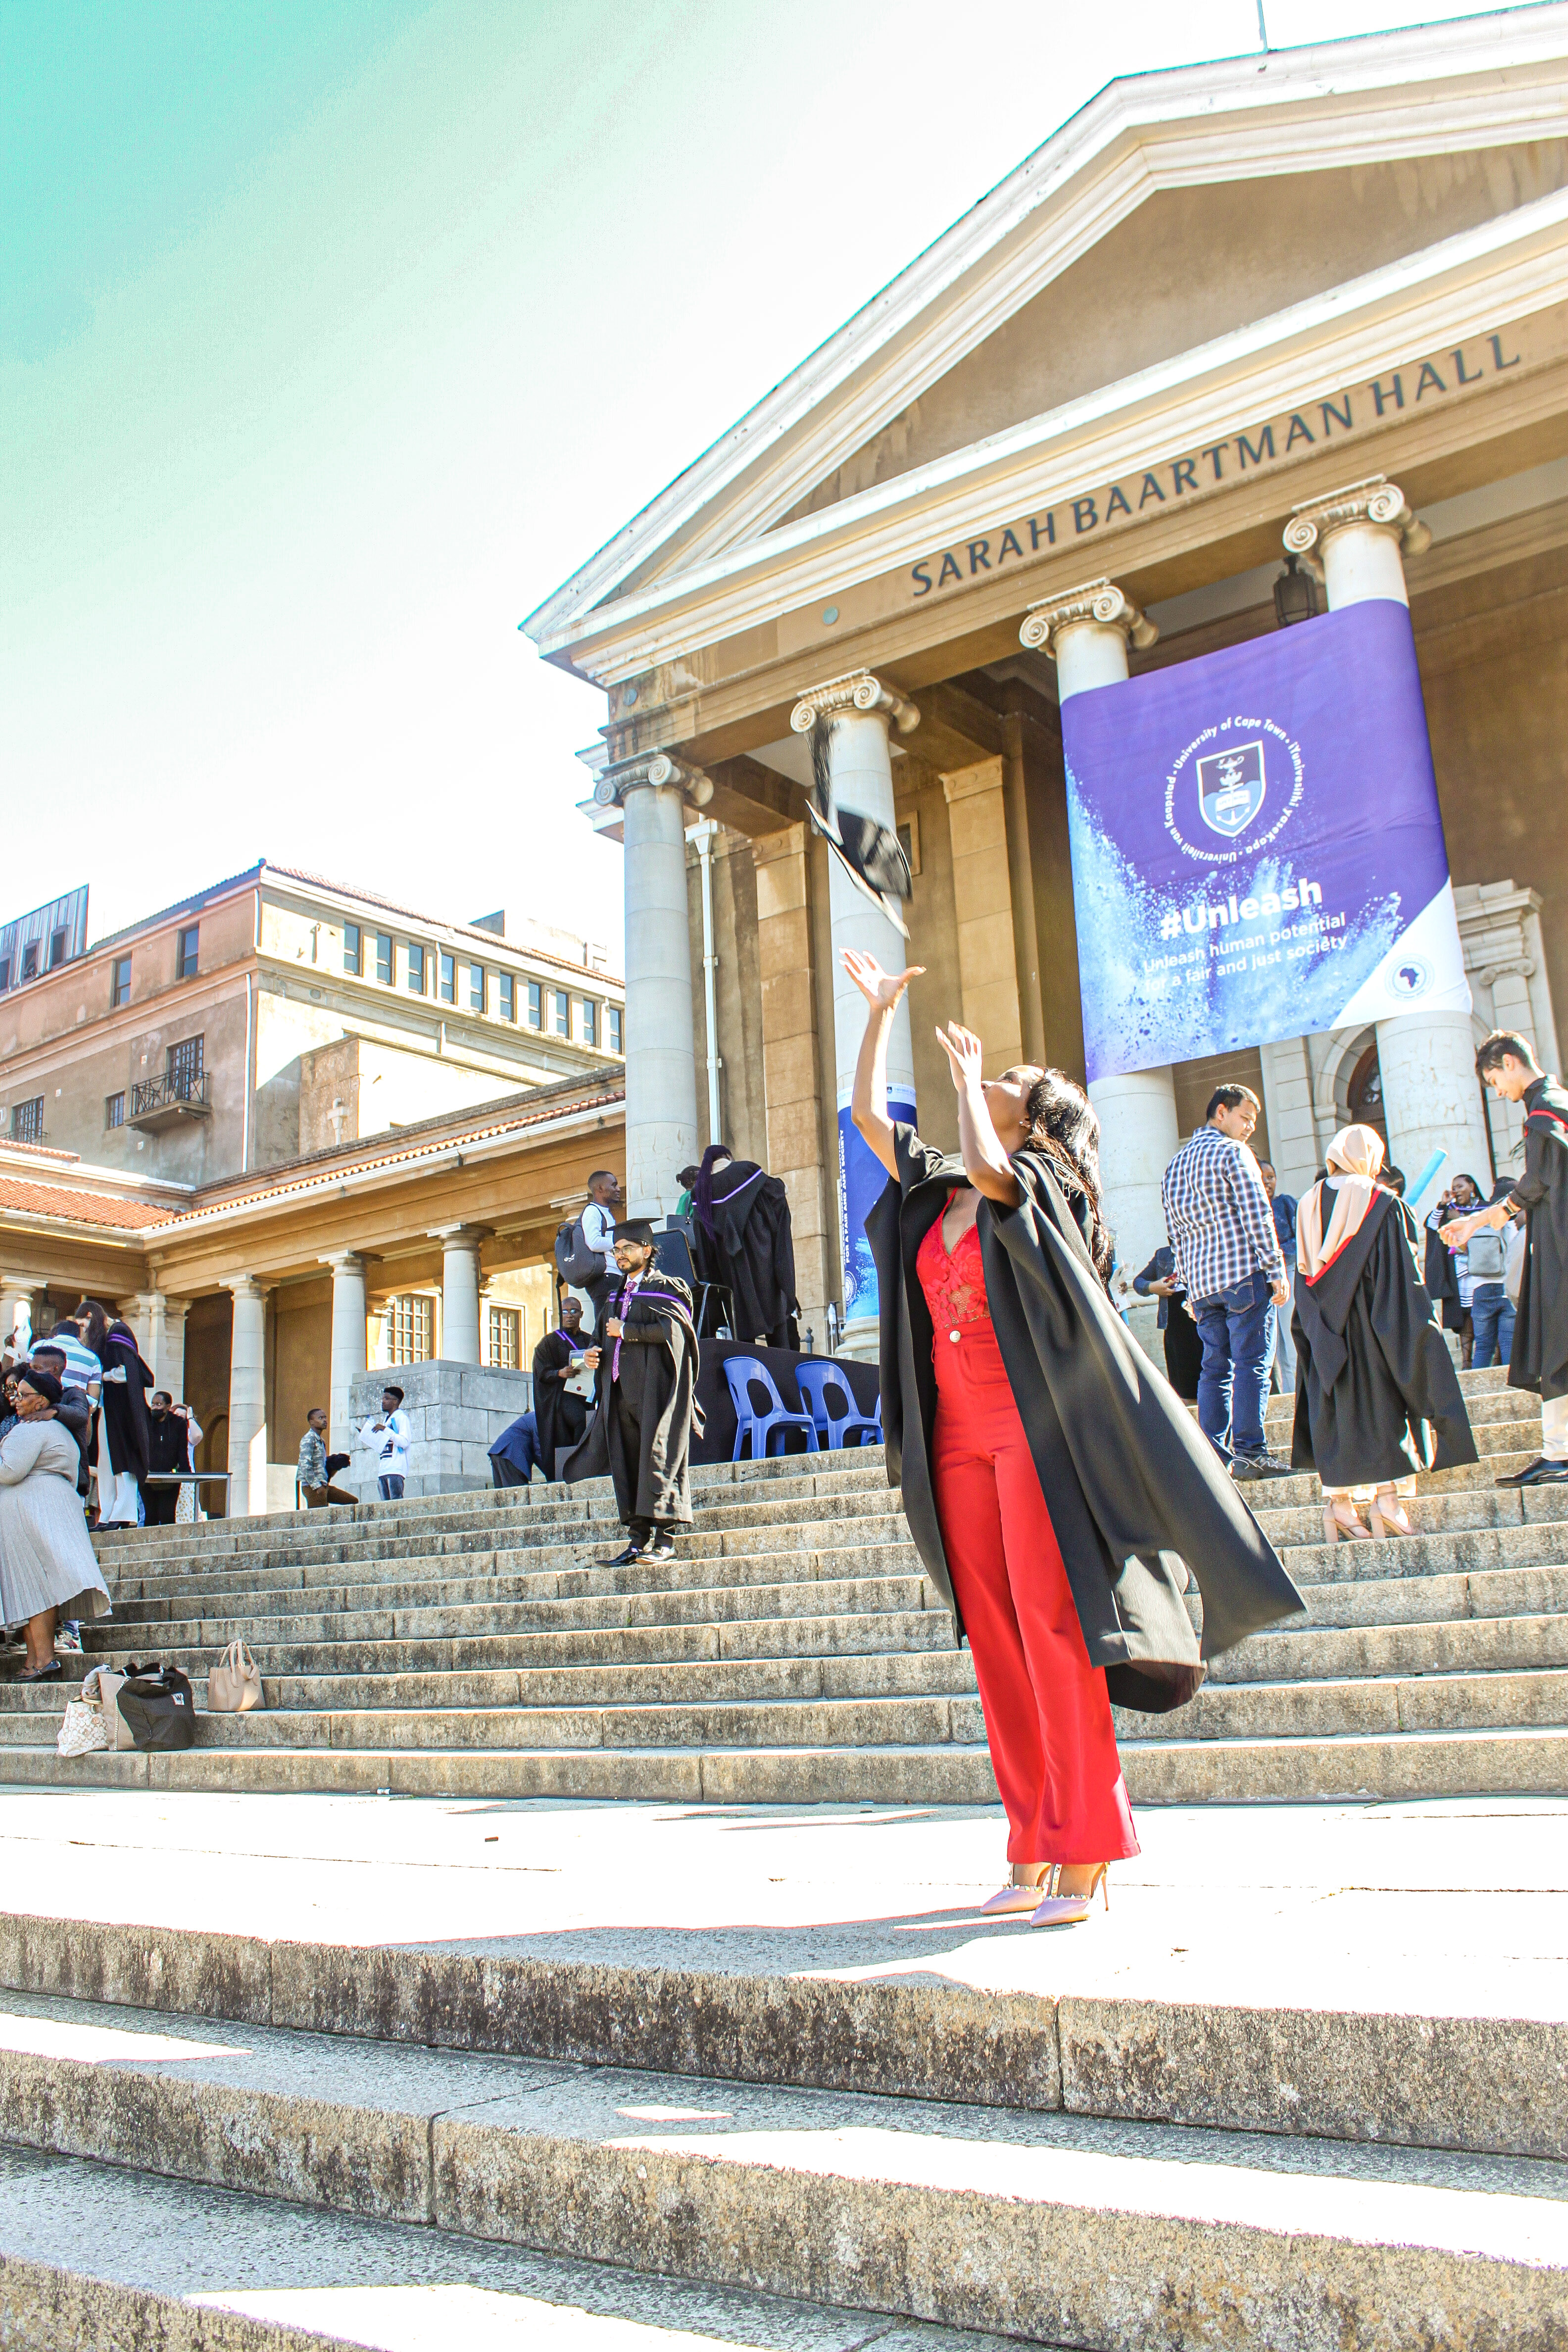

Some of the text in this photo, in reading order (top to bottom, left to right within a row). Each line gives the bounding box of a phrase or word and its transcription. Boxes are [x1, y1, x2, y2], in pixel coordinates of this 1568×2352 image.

[911, 333, 1521, 596] SARAH BAARTMAN HALL
[1173, 716, 1287, 769] University of Cape Town
[1164, 776, 1237, 864] Universiteit van Kaapstad
[1245, 807, 1293, 854] yaseKapa
[1160, 877, 1323, 940] #Unleash
[1143, 911, 1346, 973] Unleash human potential
[1146, 935, 1348, 991] for a fair and just society
